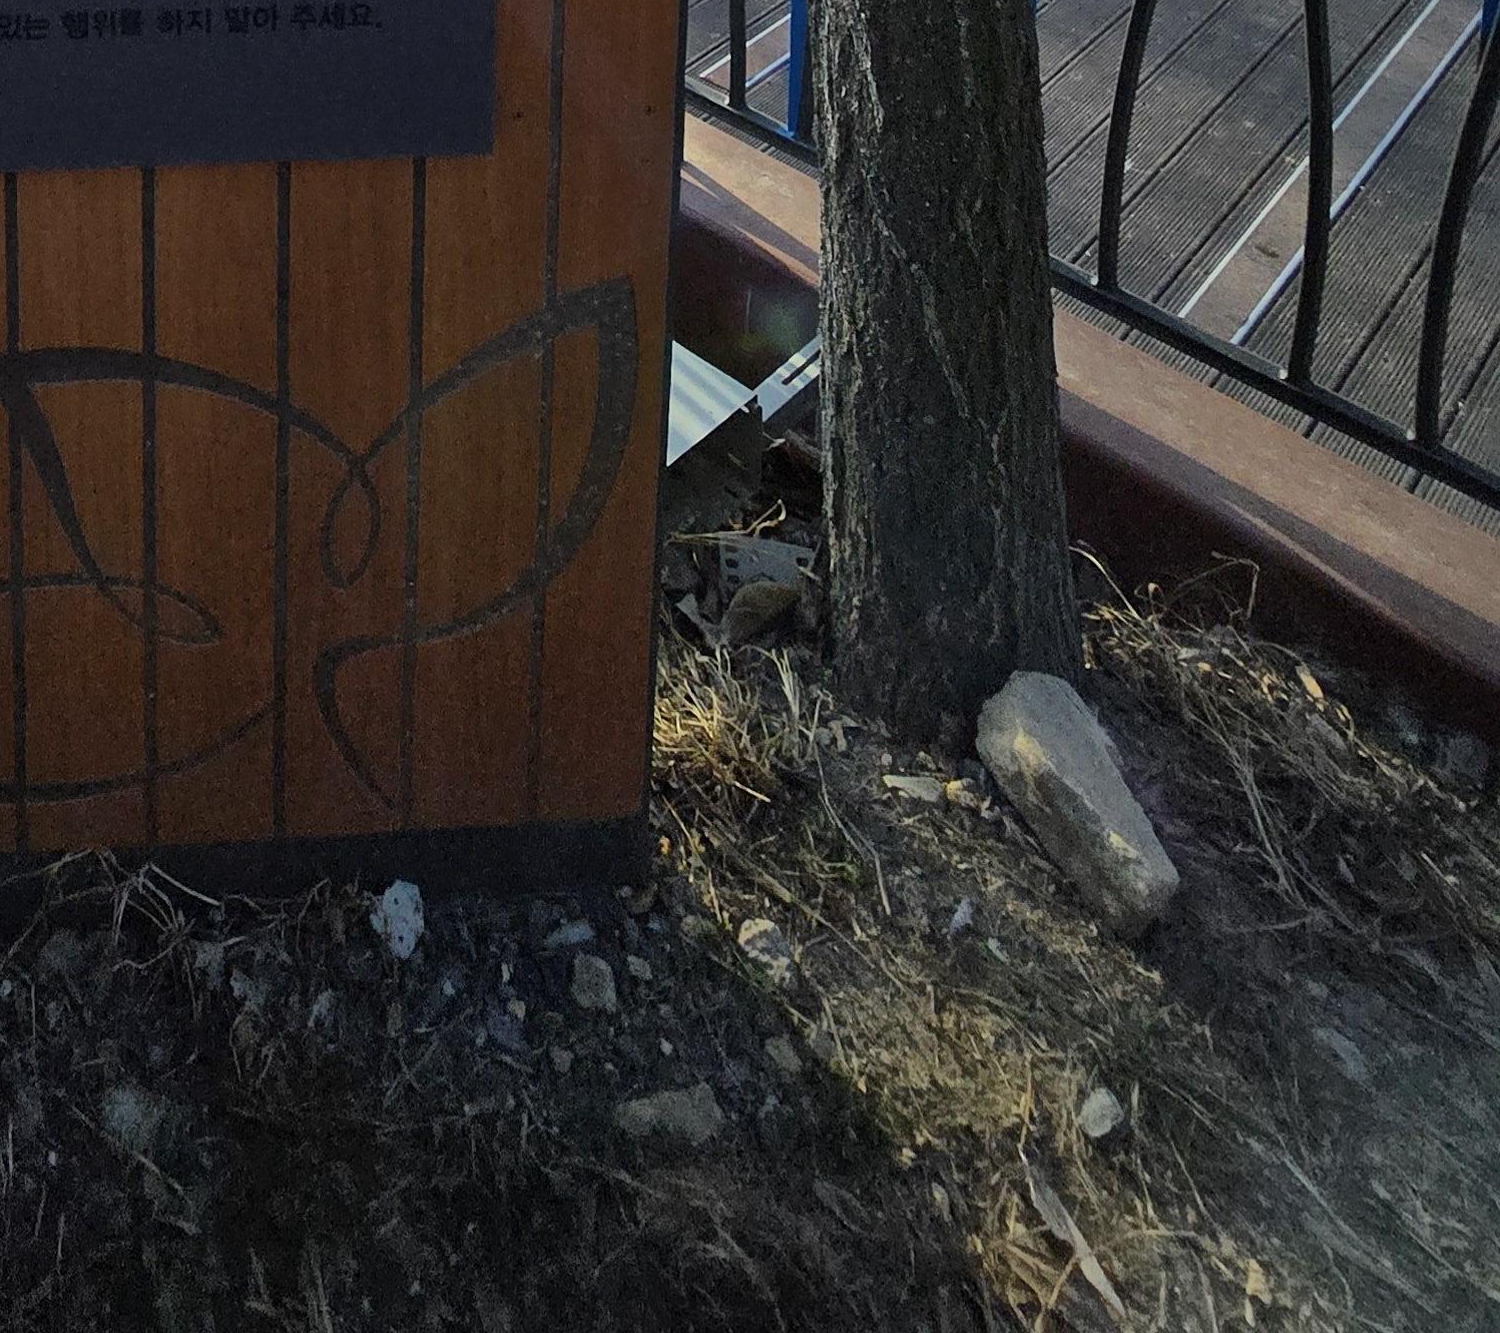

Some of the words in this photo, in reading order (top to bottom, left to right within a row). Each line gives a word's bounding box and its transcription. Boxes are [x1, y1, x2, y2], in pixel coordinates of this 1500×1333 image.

[61, 8, 143, 39] 행위를
[157, 8, 212, 36] 하지
[224, 4, 280, 34] 말아
[290, 2, 383, 31] 주세요.
